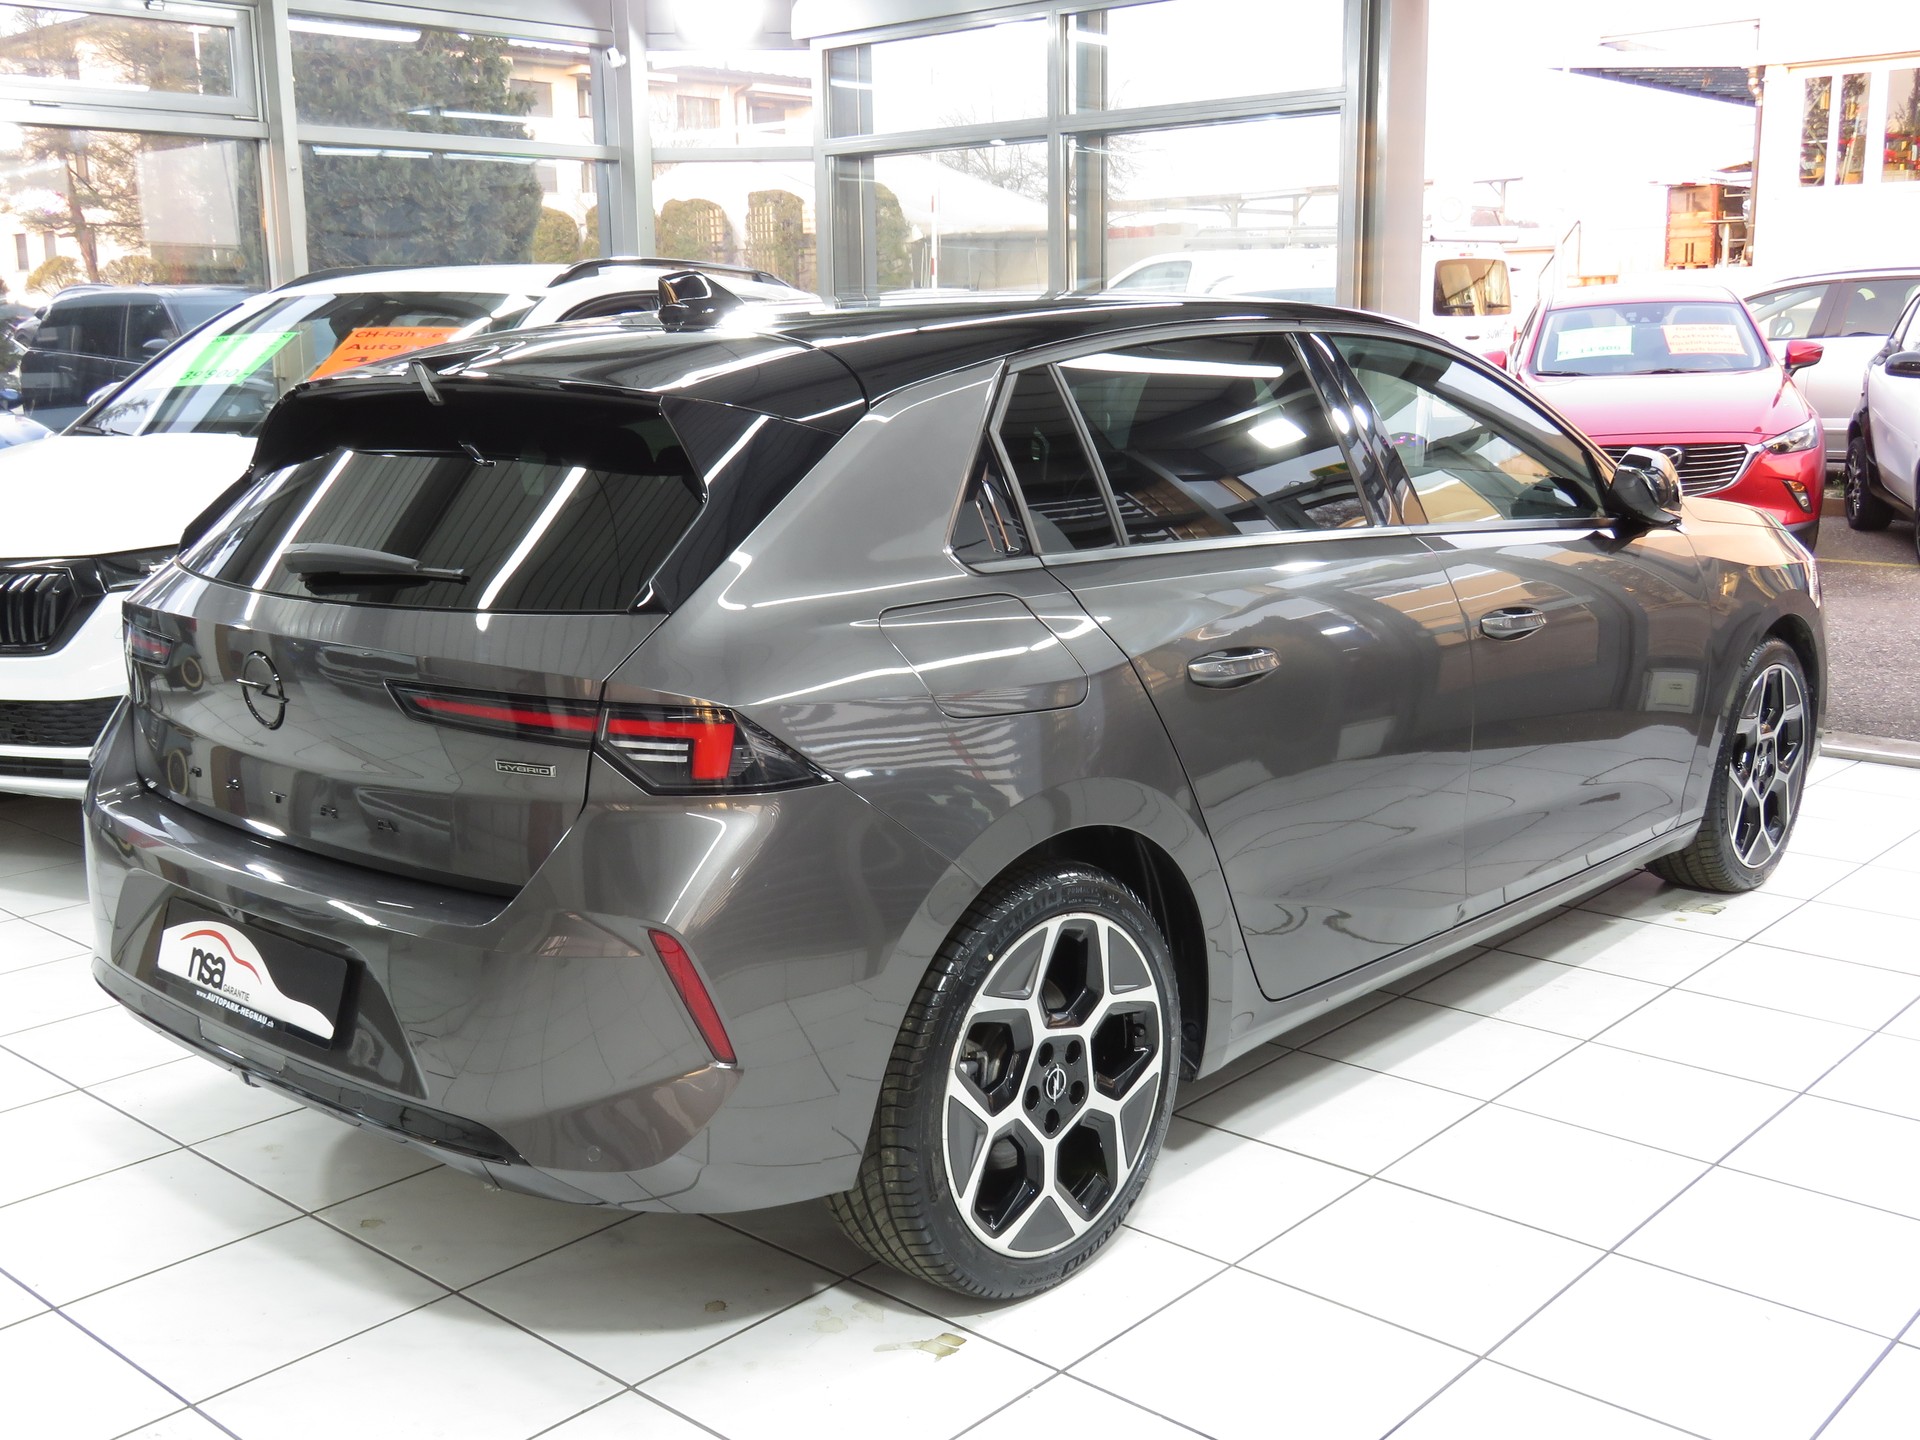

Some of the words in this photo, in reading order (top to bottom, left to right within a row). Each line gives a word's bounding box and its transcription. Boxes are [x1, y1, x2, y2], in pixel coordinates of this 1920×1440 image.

[498, 763, 550, 775] HYBRID
[188, 946, 226, 990] nsa
[223, 984, 250, 1002] GARANTIE
[195, 989, 275, 1028] www.AUTOPARK-HEGNAU.ch
